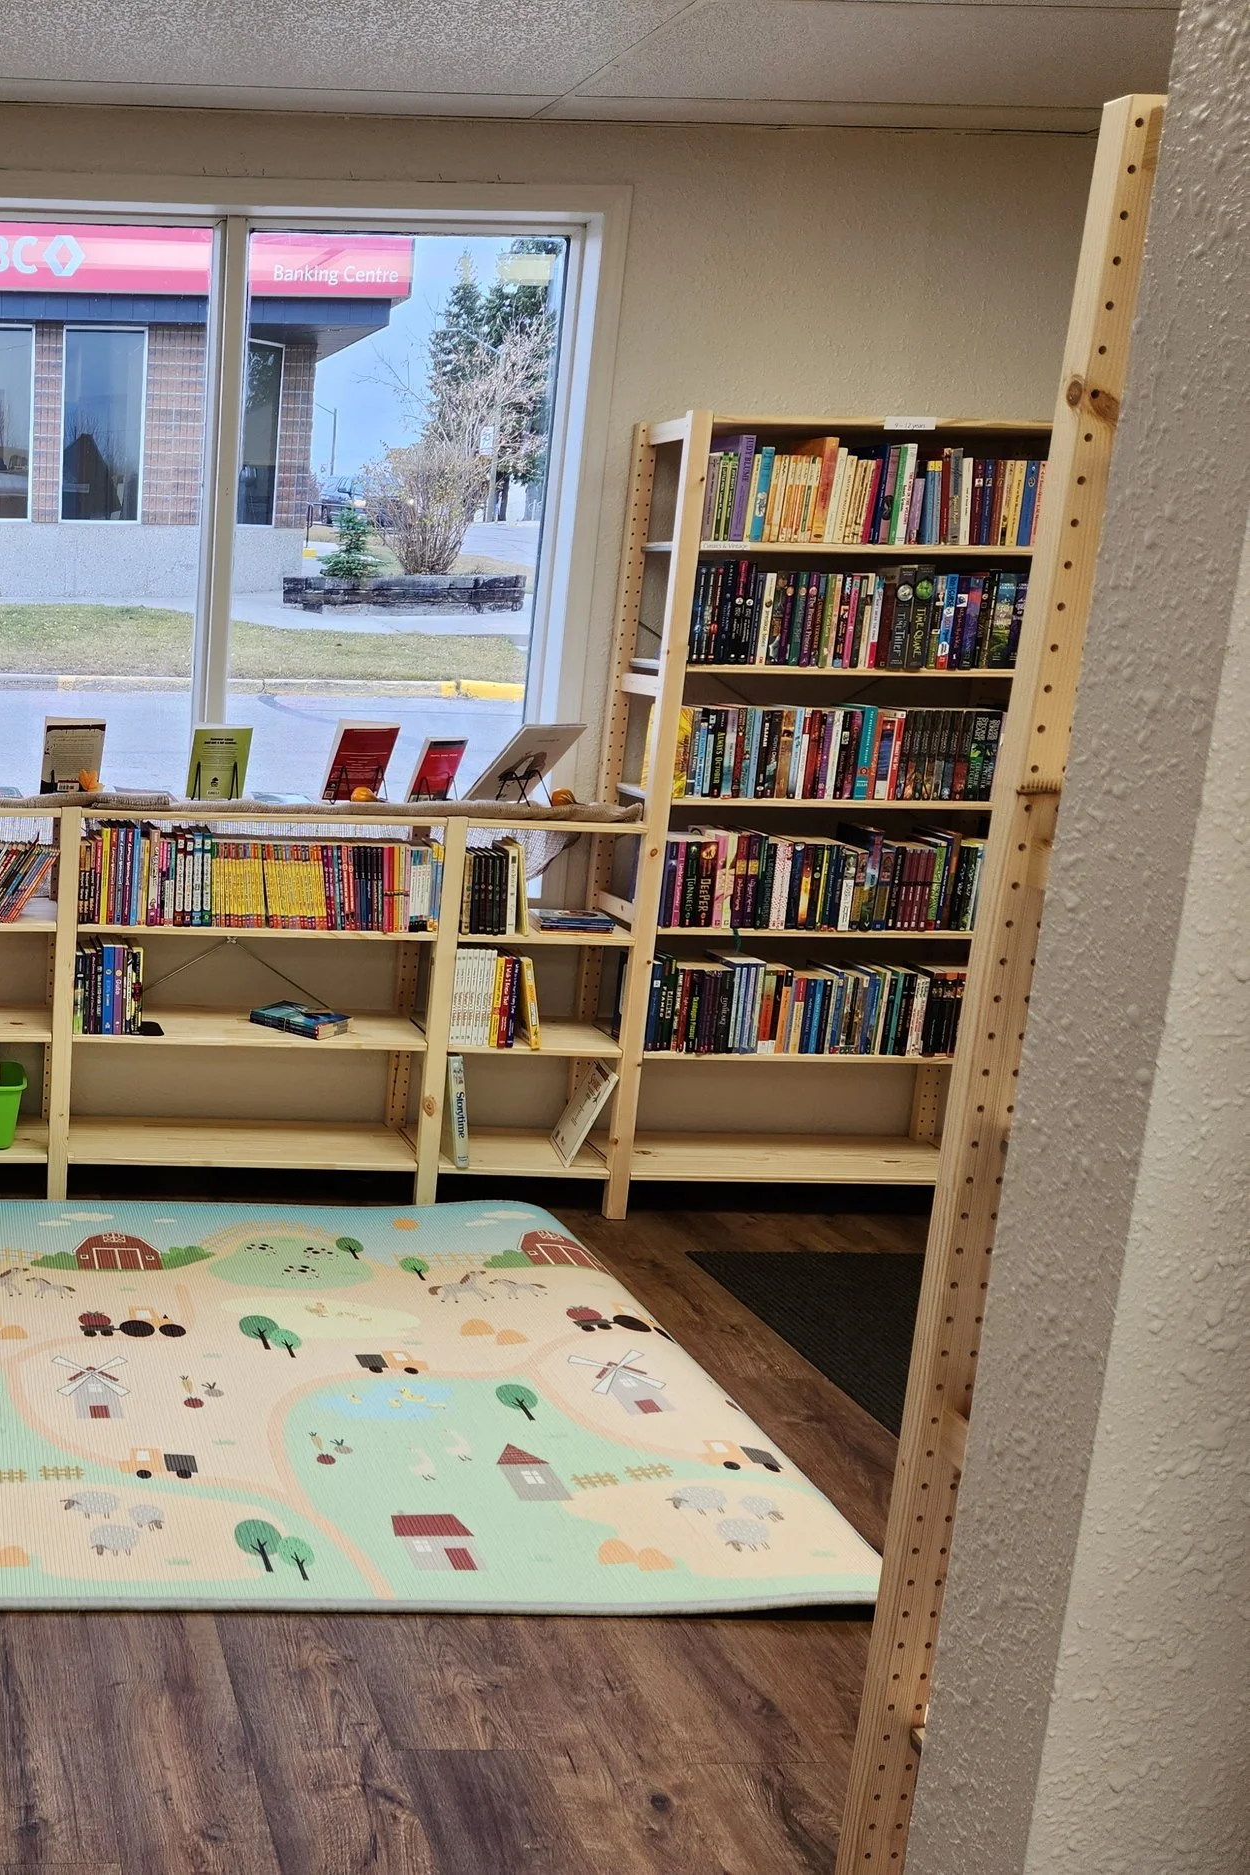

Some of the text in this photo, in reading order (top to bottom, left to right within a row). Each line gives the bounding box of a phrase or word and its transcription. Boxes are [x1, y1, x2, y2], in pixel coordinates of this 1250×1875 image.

[274, 265, 398, 284] Banking Centre
[912, 423, 926, 431] years
[742, 437, 755, 482] JUDY BLUME
[894, 612, 905, 656] TIME THIEF
[913, 607, 927, 658] TIME QUAKE
[974, 718, 983, 740] HEART
[713, 732, 725, 784] ALWAYS OCTOBER
[967, 760, 976, 788] FLETCHER
[685, 875, 696, 911] TUNNELS
[699, 878, 711, 911] DEEPER
[455, 1092, 465, 1139] Storytime
